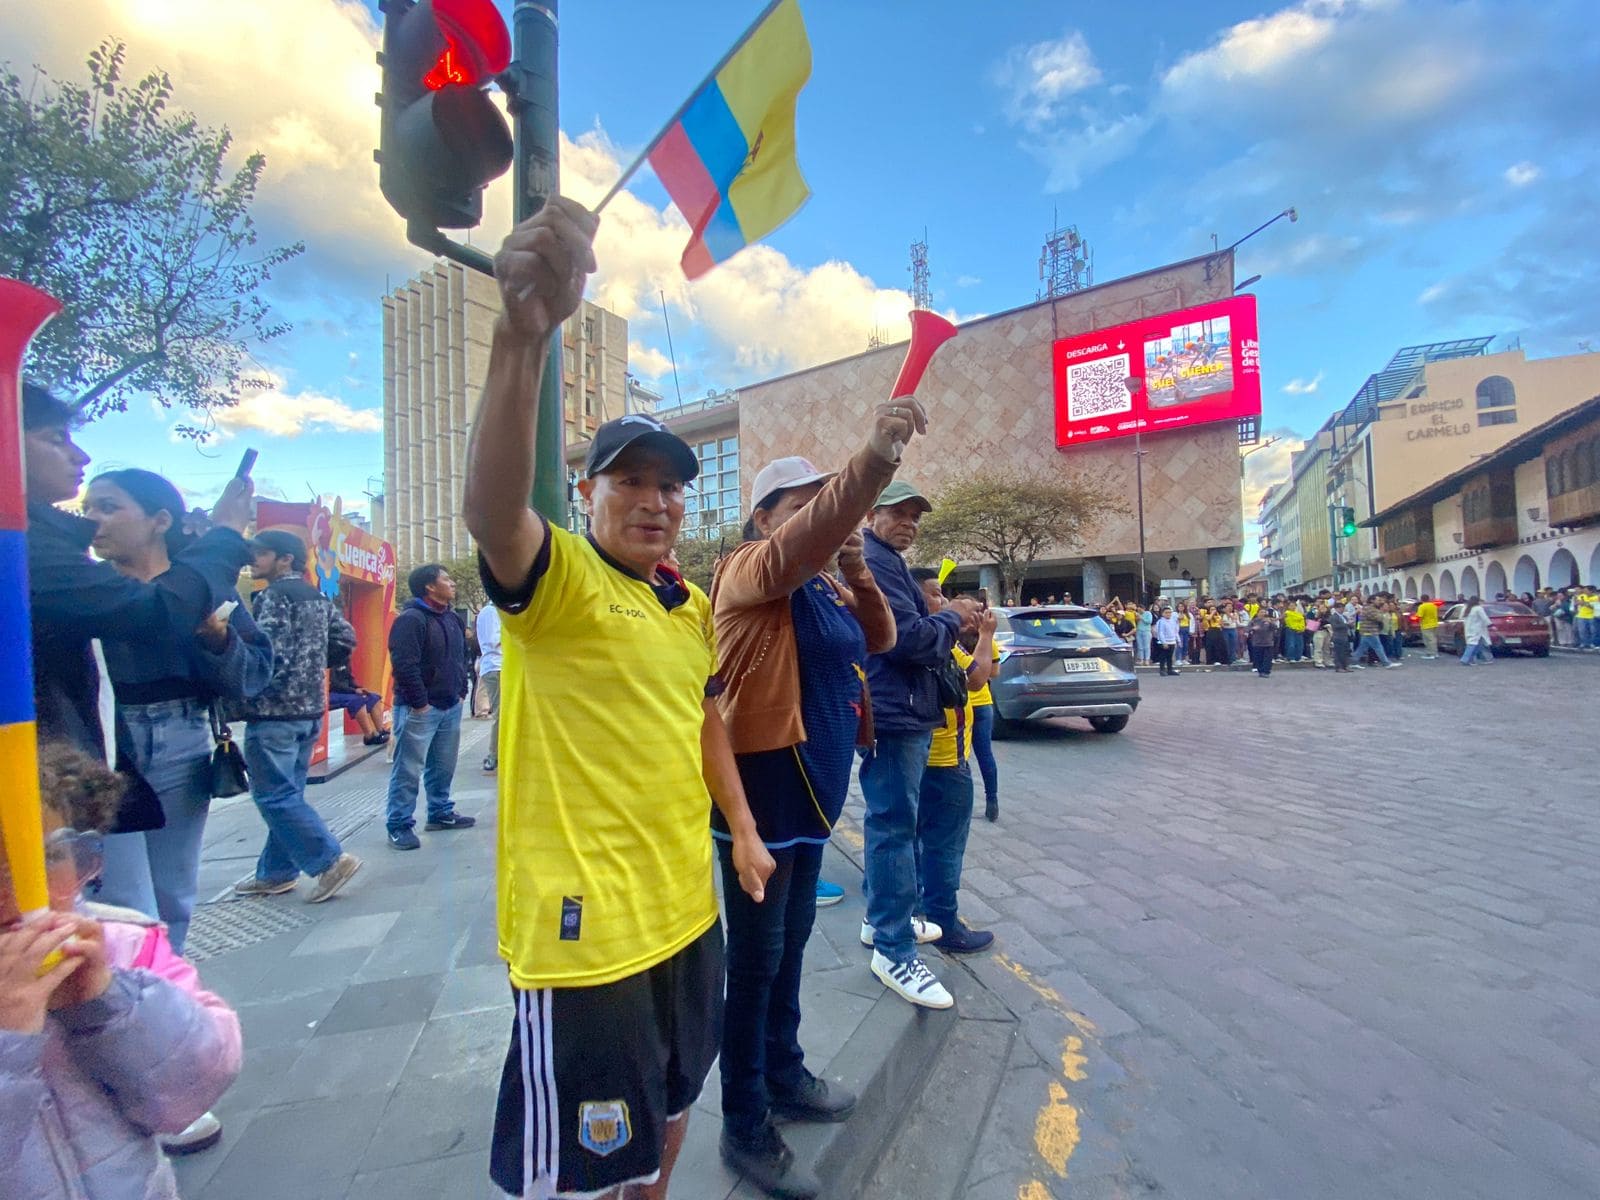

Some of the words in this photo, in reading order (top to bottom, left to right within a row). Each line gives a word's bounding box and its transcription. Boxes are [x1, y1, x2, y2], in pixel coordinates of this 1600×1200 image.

[1066, 343, 1108, 359] DESCARGA
[1411, 399, 1463, 415] EDIFICIO
[1431, 414, 1448, 425] EL
[1407, 422, 1471, 441] CARMELO
[336, 532, 378, 573] Cuenca
